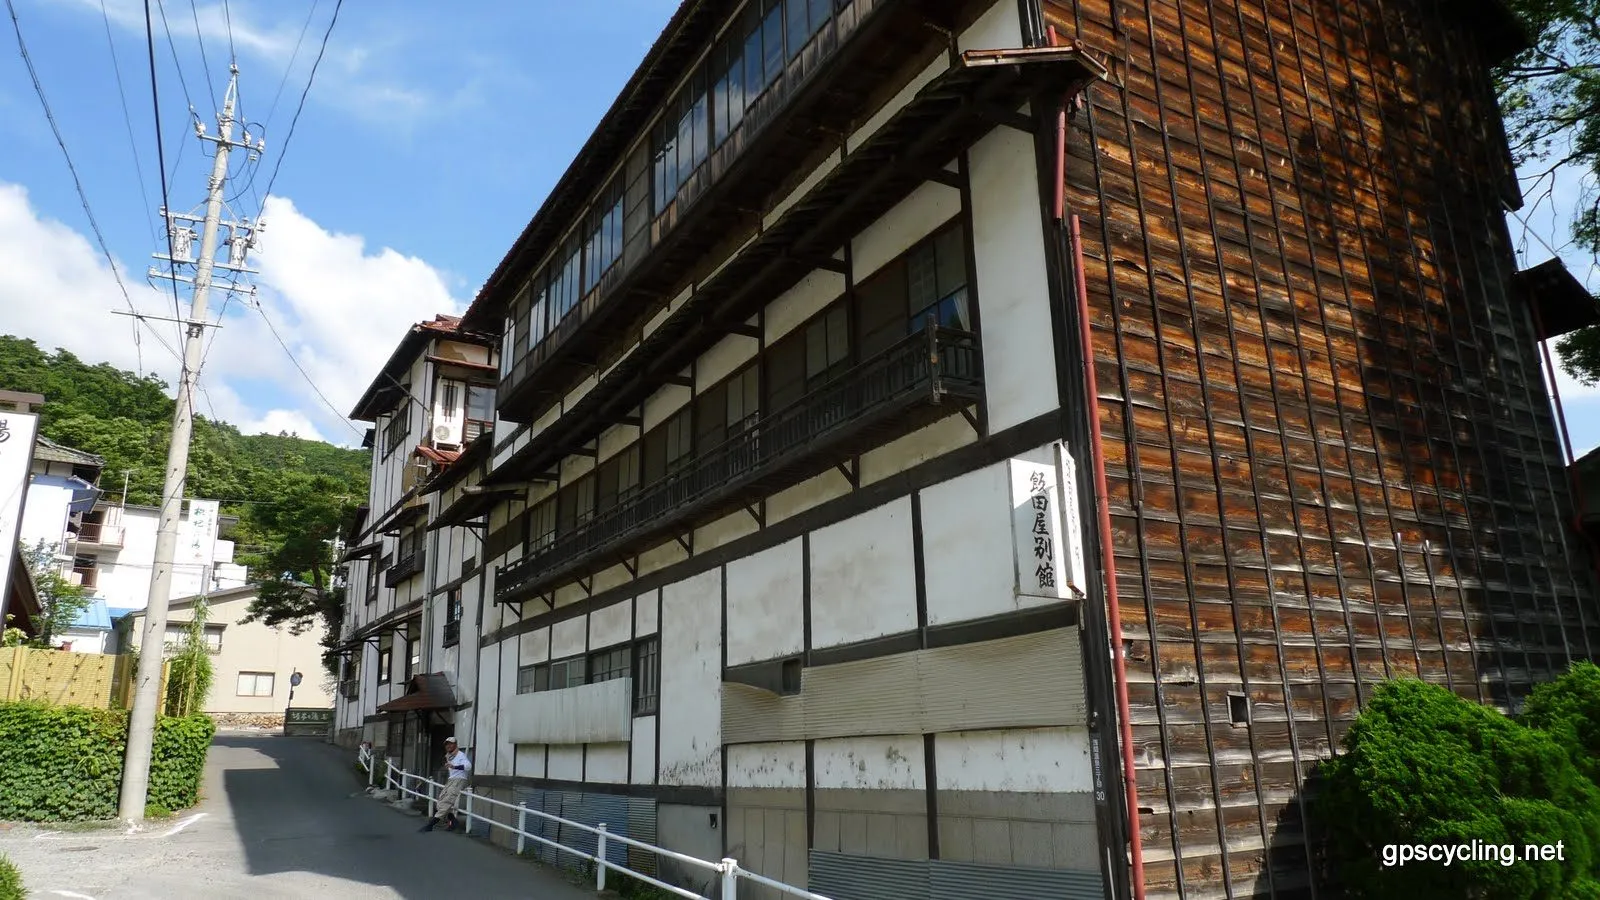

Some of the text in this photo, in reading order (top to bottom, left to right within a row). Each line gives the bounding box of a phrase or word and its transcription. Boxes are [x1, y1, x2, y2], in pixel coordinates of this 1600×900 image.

[1029, 470, 1055, 588] 飯田屋別館
[1096, 791, 1105, 801] 30
